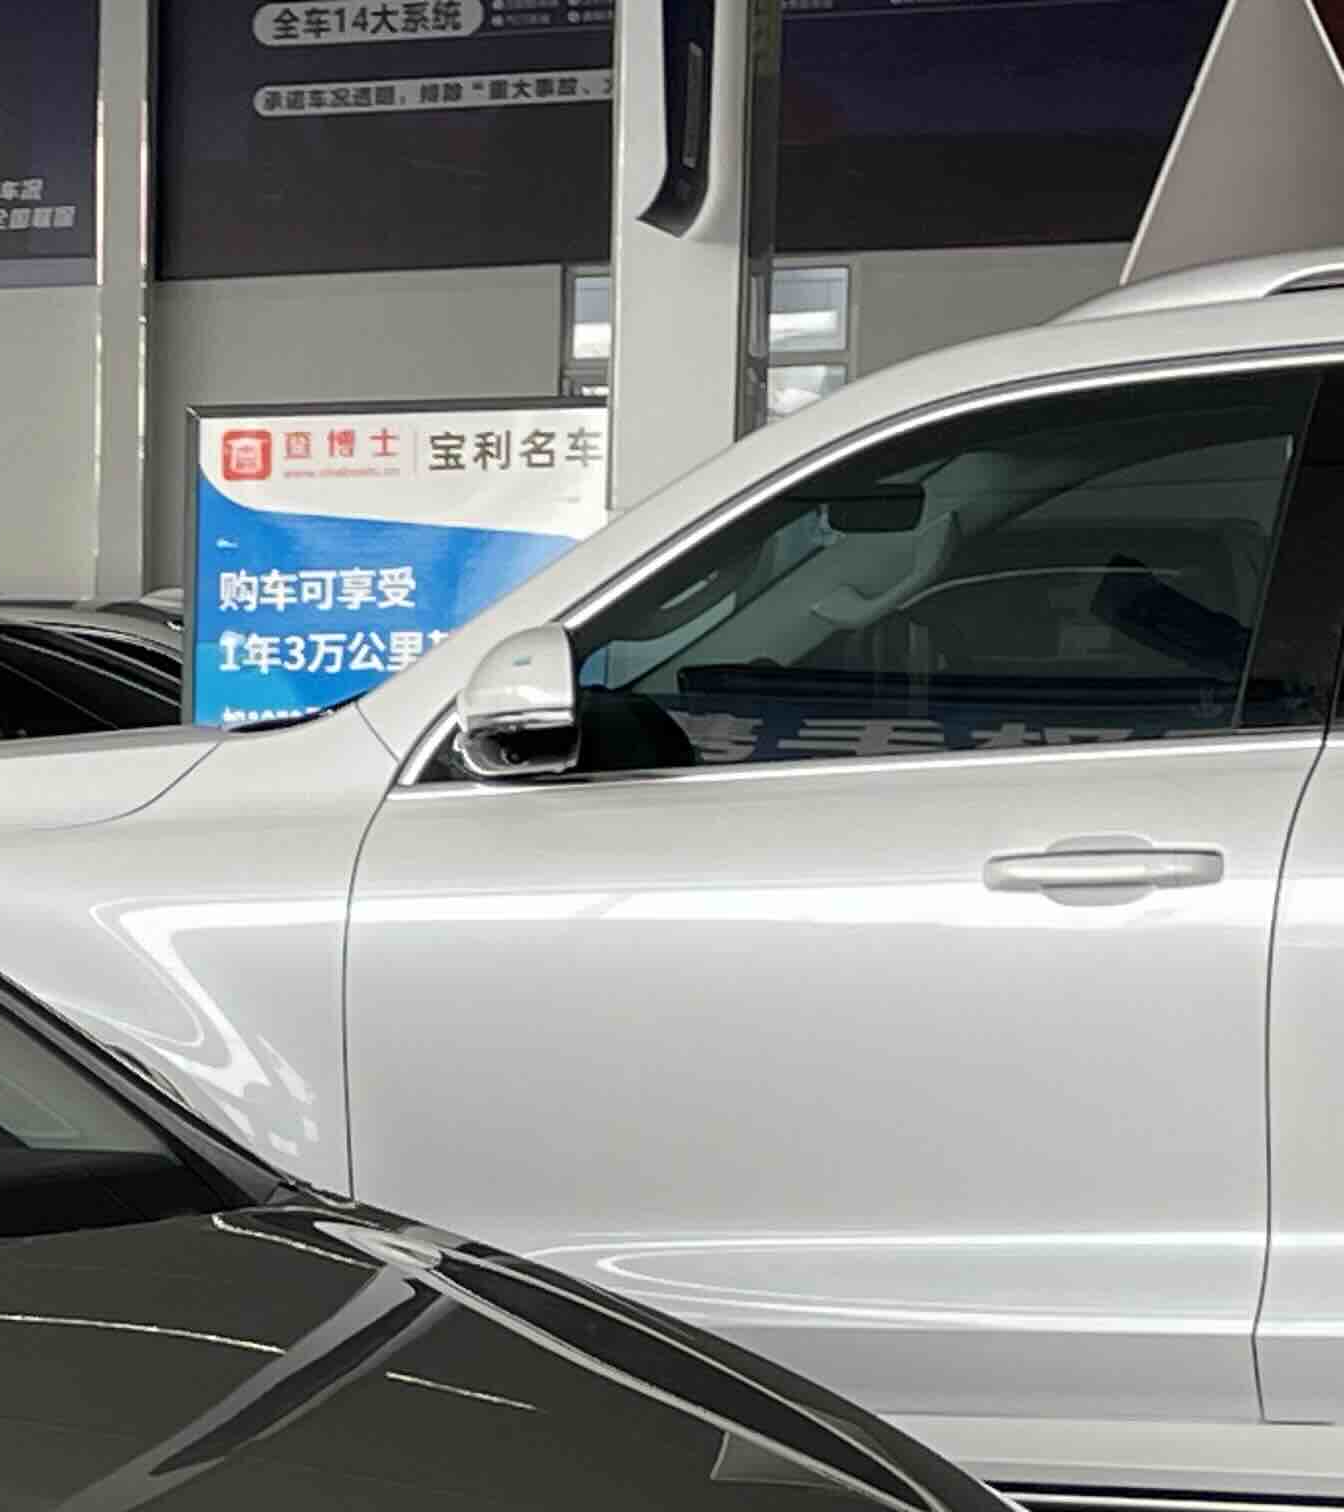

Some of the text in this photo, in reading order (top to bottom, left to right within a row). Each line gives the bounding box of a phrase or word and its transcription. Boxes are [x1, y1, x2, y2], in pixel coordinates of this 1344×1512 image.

[272, 1, 463, 40] 全车14大系统
[427, 427, 604, 472] 宝利名车
[218, 565, 417, 612] 购车可享受
